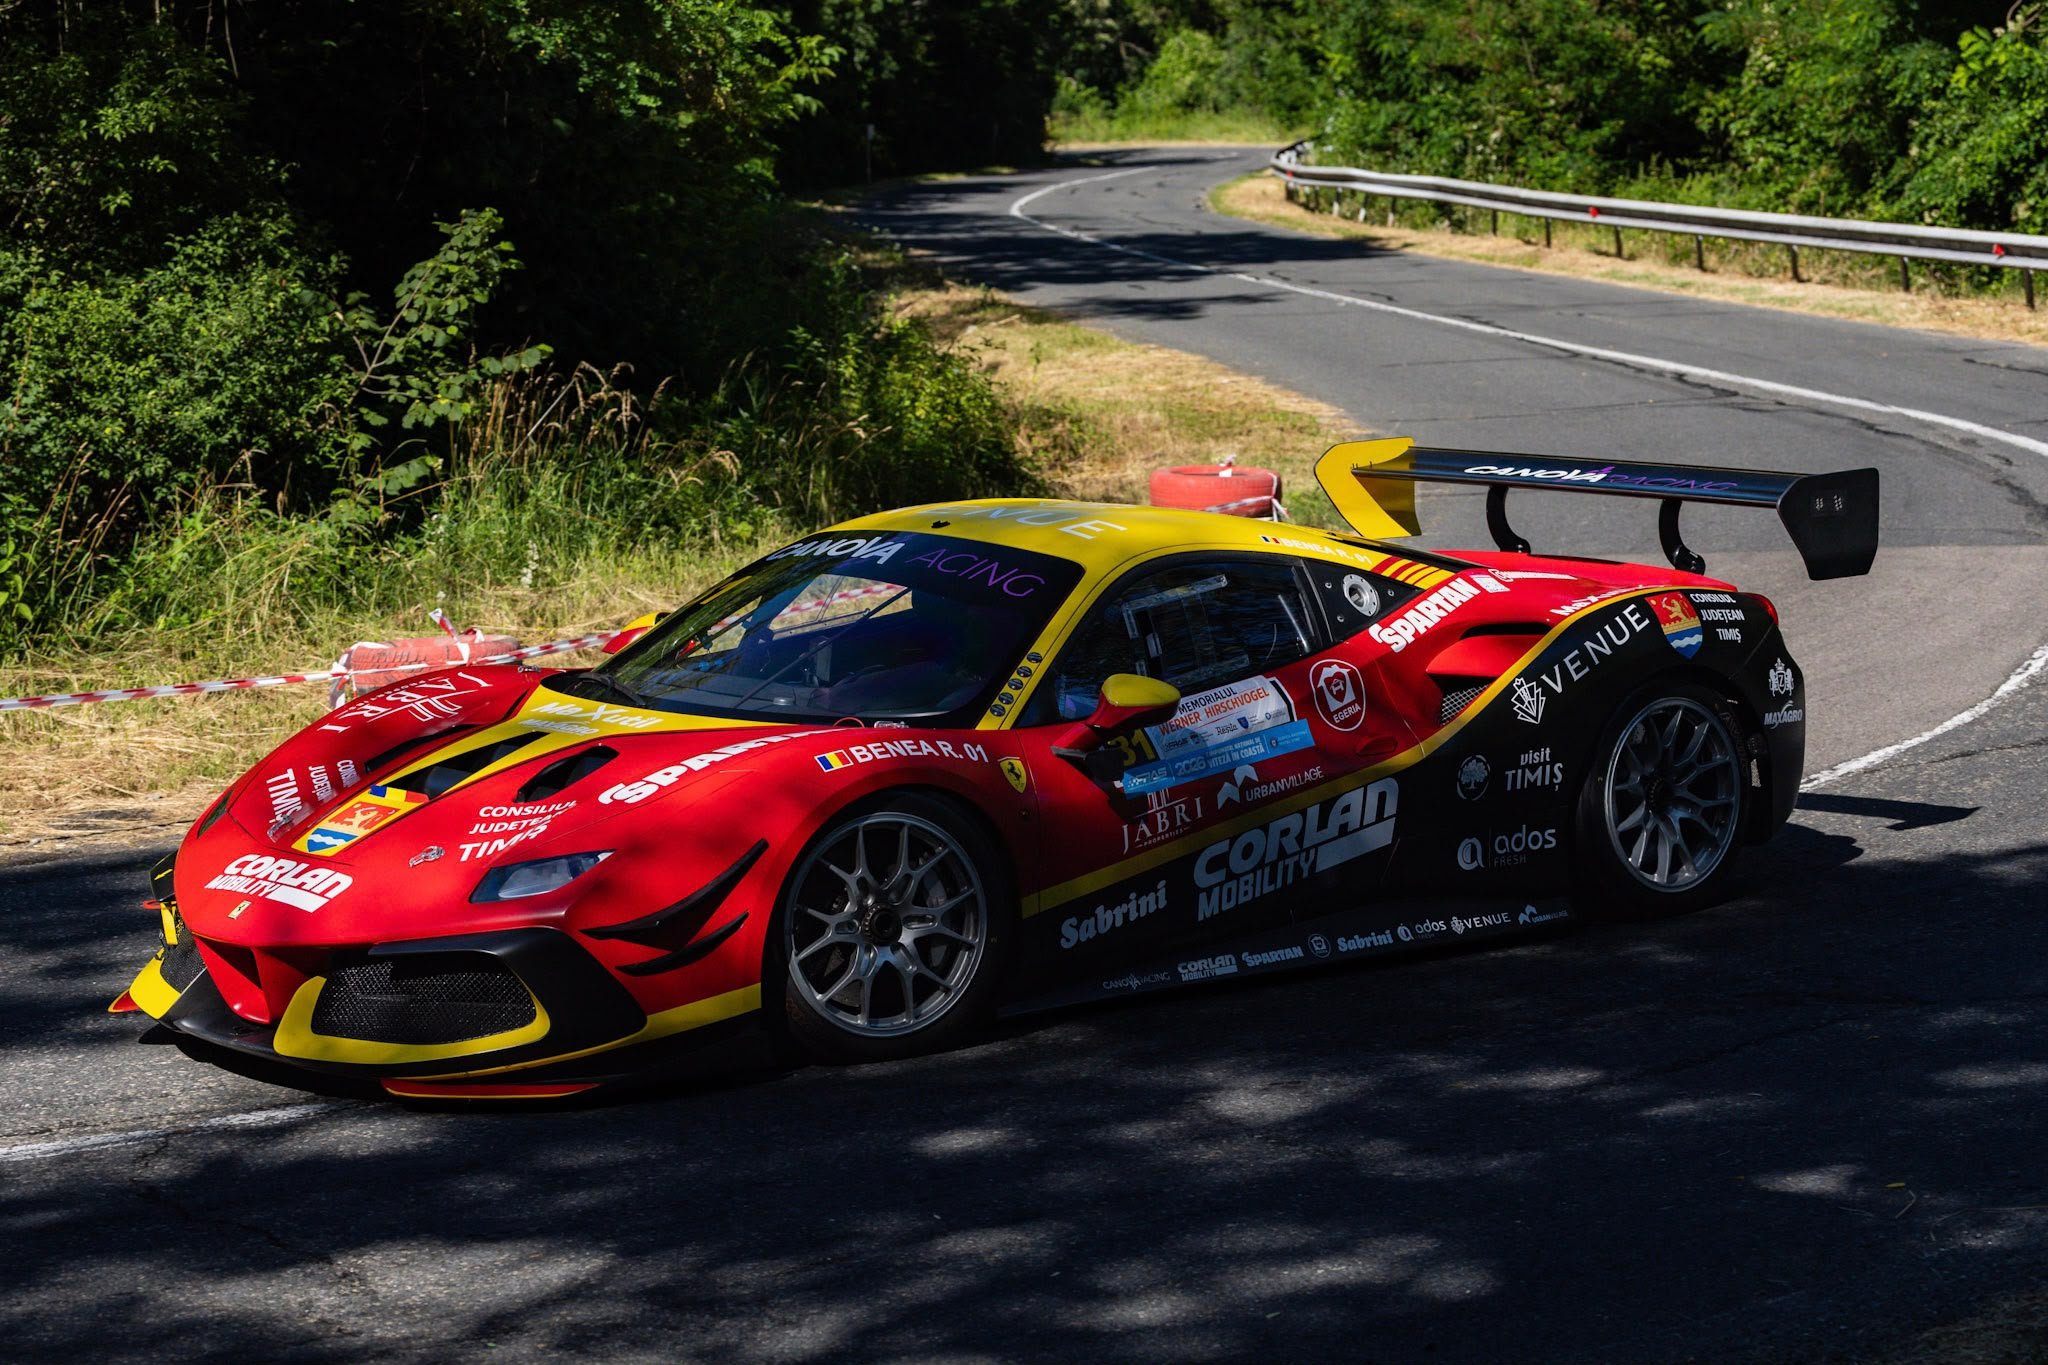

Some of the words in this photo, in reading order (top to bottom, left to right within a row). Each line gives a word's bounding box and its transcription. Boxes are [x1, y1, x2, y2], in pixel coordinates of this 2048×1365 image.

[1463, 465, 1607, 483] CANOVA
[766, 536, 906, 565] CANOVA
[1280, 538, 1336, 556] BENEA
[1689, 592, 1737, 604] CONSILIUL
[1370, 577, 1481, 653] SPARTAN
[1540, 603, 1650, 695] VENUE
[1159, 713, 1201, 737] WERNER
[1205, 686, 1270, 719] HIRSCHVOGEL
[1178, 686, 1238, 714] MEMORIALUL
[1332, 703, 1362, 724] EGERIA
[849, 740, 941, 763] BENEA
[937, 740, 963, 759] R.
[963, 743, 989, 763] 01
[1520, 747, 1551, 766] visit
[1245, 766, 1325, 802] URBANVILLAGE
[1123, 798, 1204, 855] JABRI
[1194, 777, 1399, 888] CORLAN
[1494, 824, 1557, 854] ados
[1494, 854, 1527, 867] FRESH
[204, 874, 281, 897] MOBILITY
[224, 854, 354, 899] CORLAN
[1198, 847, 1317, 922] MOBILITY
[1059, 879, 1168, 949] Sabrini
[1464, 912, 1512, 930] VENUE
[1415, 918, 1447, 934] ados
[1337, 930, 1394, 952] Sabrini
[1178, 954, 1237, 974] CORLAN
[1242, 946, 1304, 967] SPARTAN
